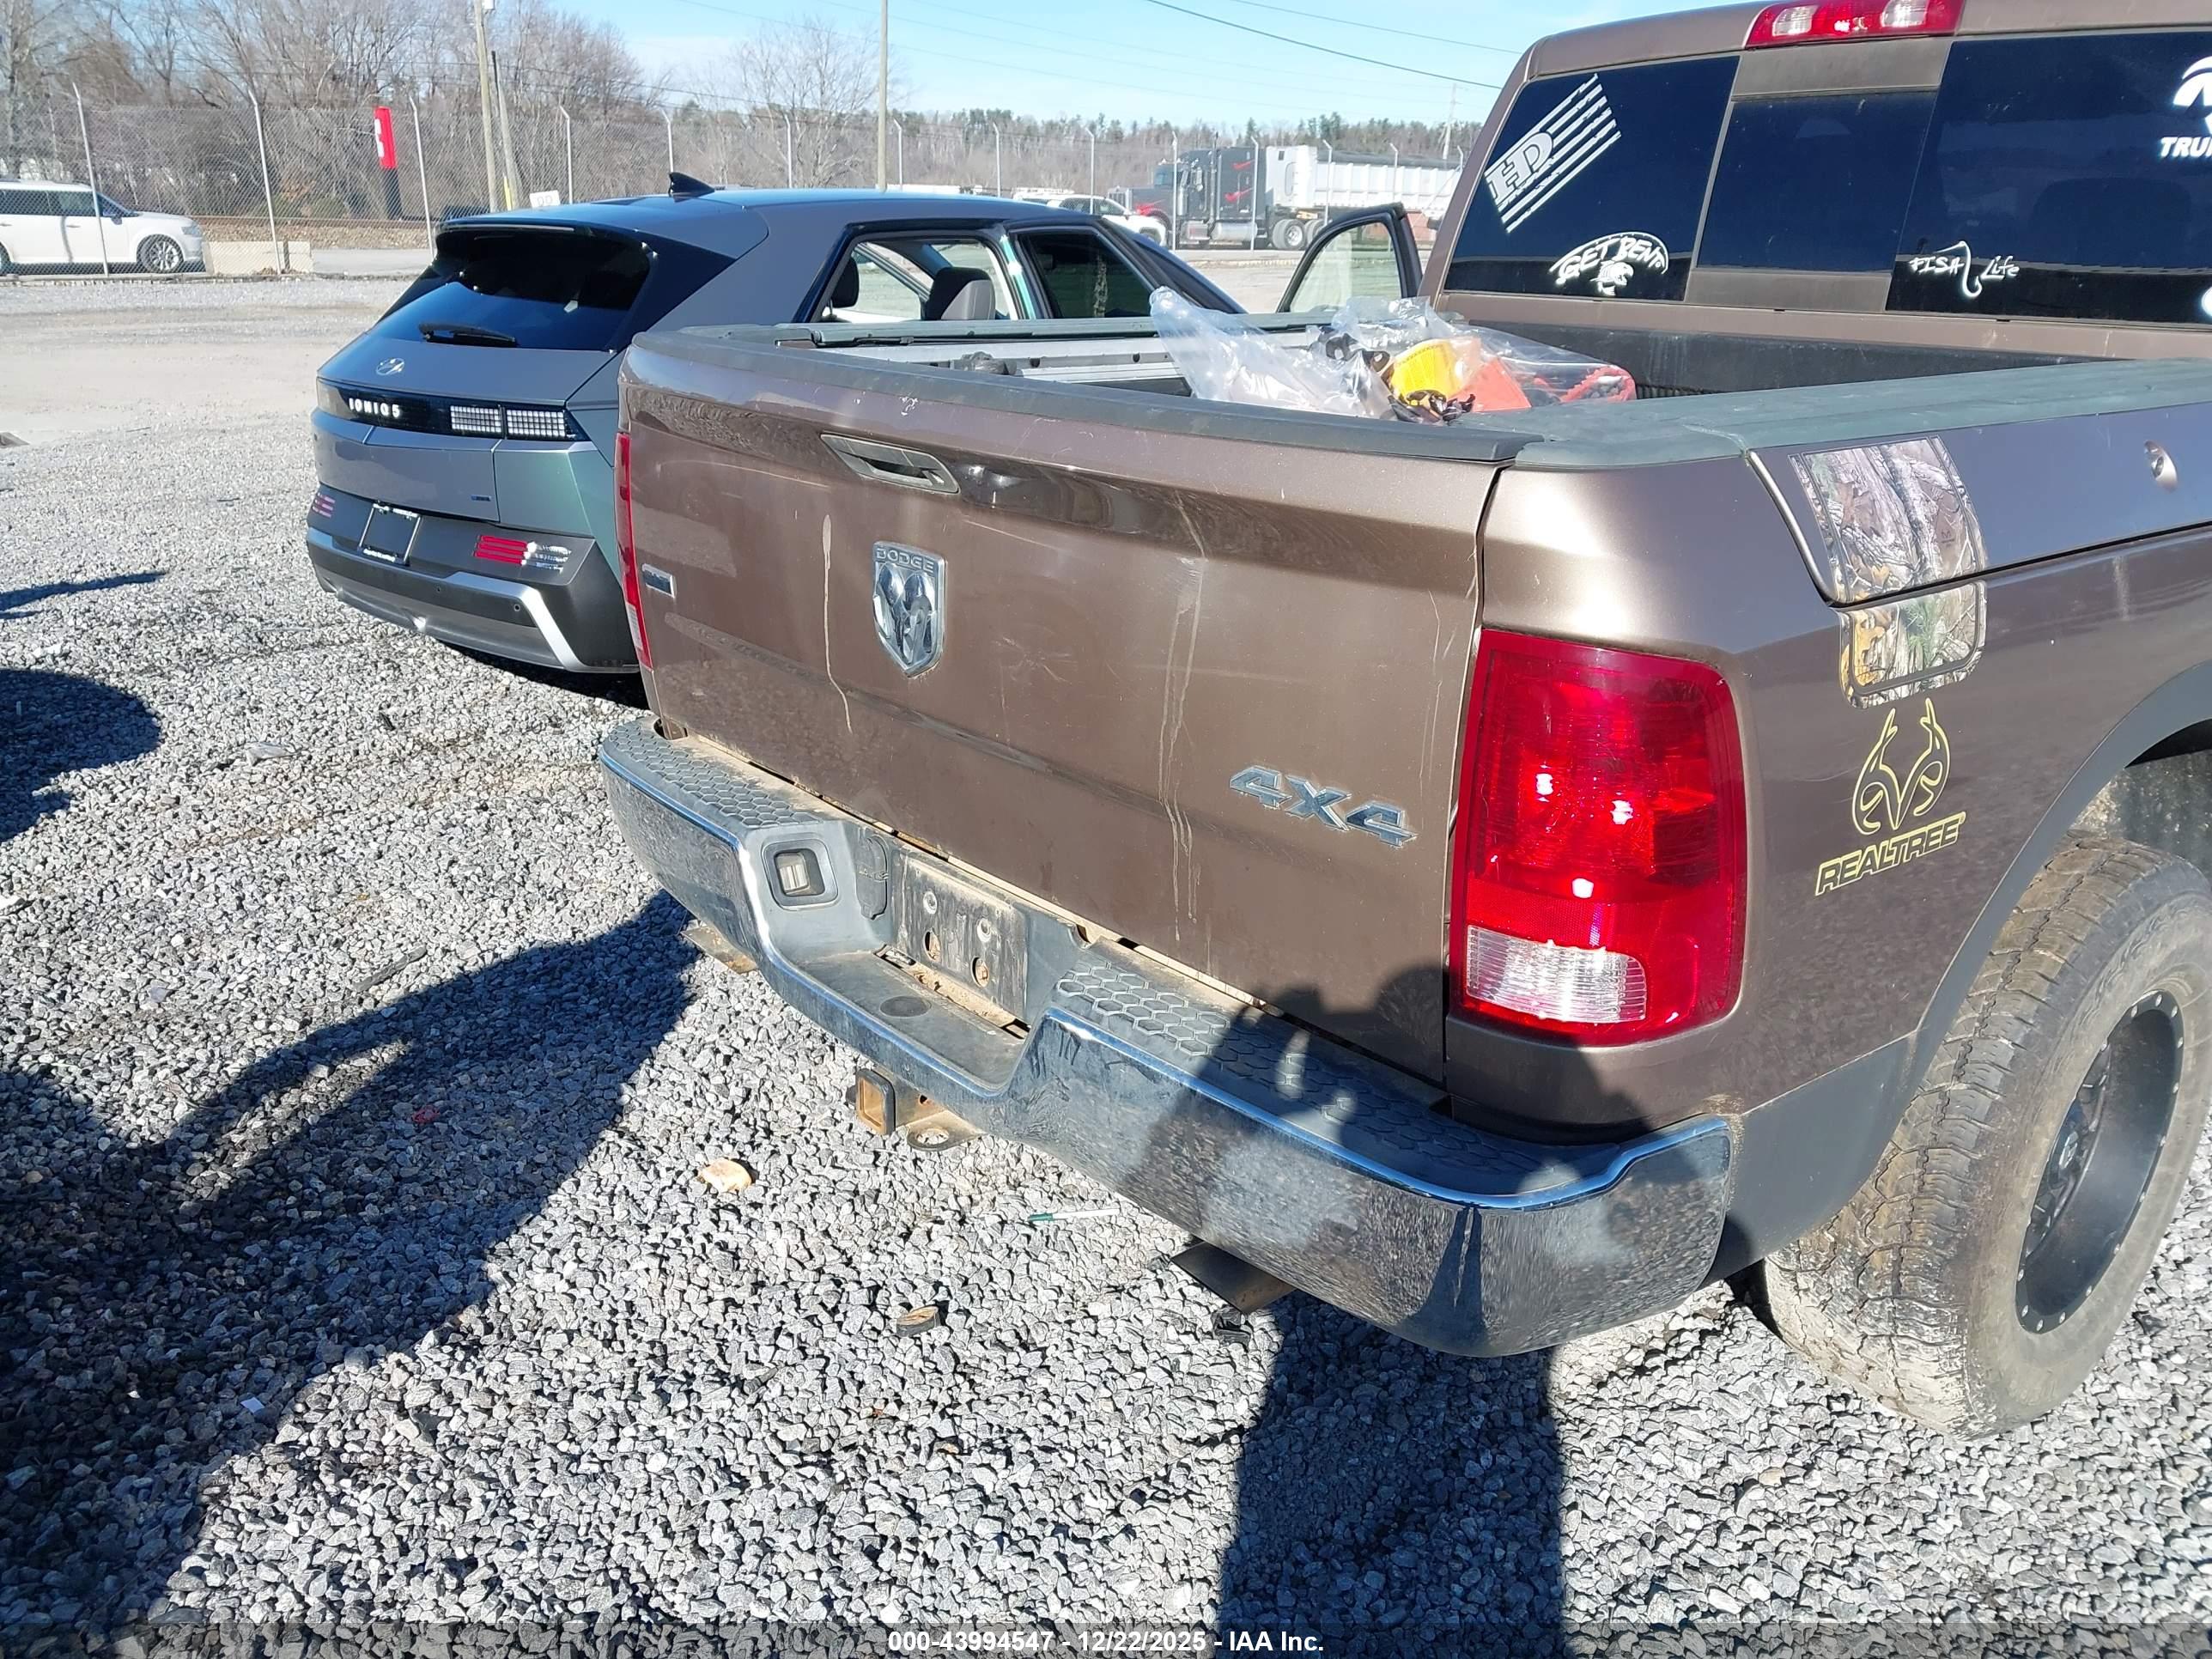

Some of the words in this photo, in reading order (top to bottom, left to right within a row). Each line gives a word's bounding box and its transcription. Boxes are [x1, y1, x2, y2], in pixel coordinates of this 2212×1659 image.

[1555, 238, 1621, 284] GET
[1611, 235, 1665, 268] BENT
[876, 547, 934, 574] DODGE
[1814, 811, 1966, 896] REALTREE
